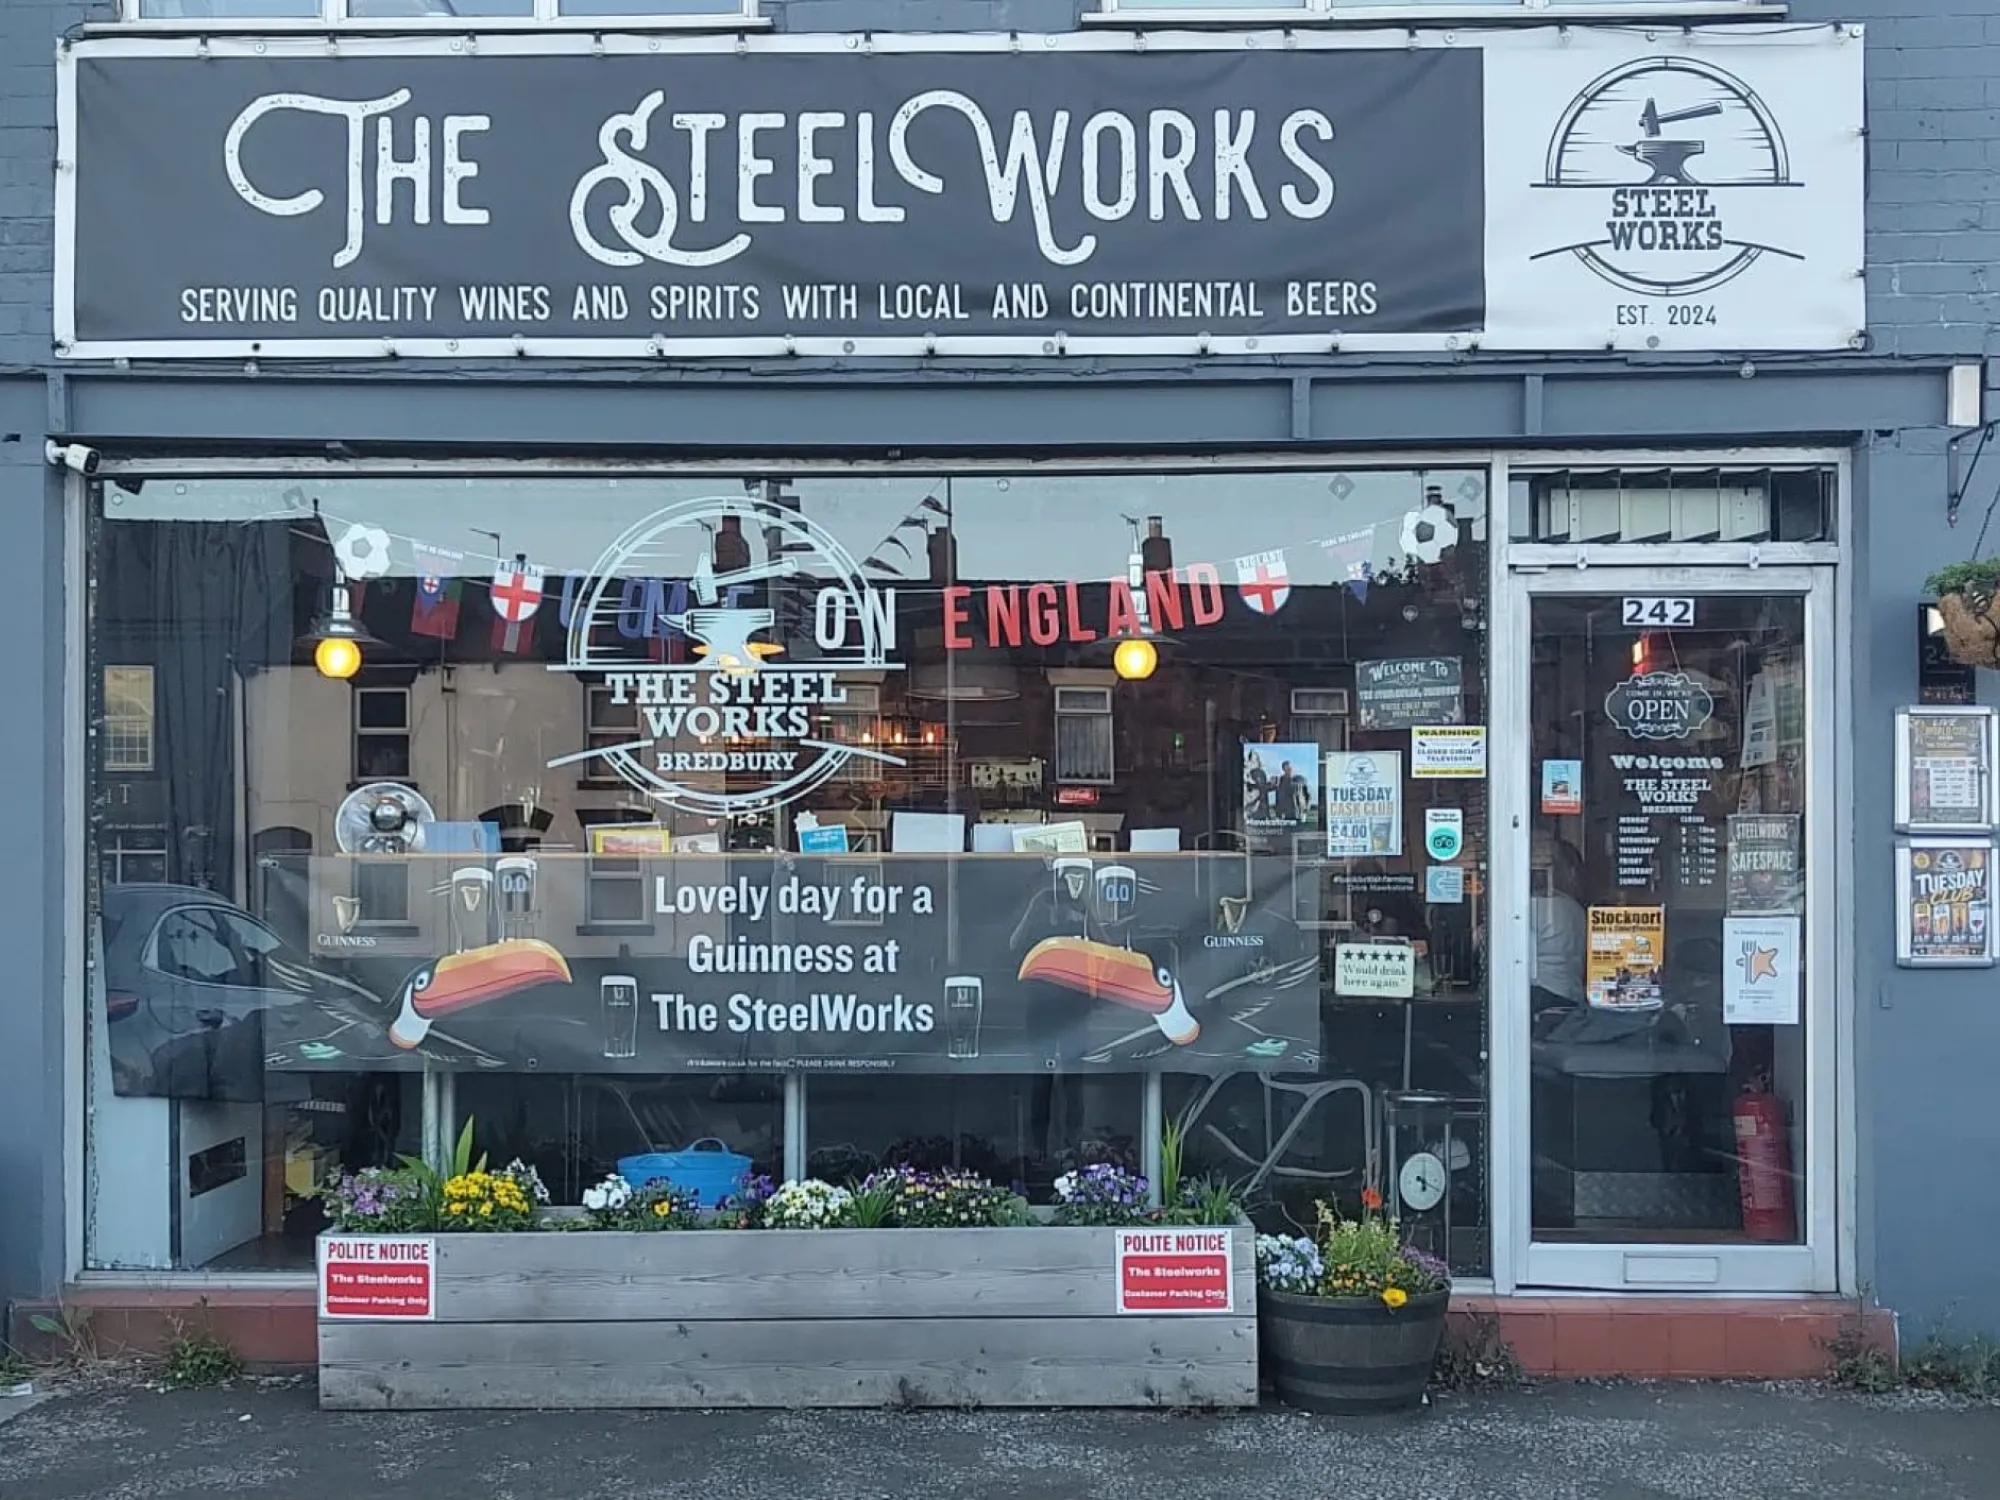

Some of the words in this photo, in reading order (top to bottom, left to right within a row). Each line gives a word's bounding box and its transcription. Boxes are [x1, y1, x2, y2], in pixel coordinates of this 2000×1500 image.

[224, 88, 490, 268] THE
[1612, 188, 1716, 218] STEEL
[1606, 221, 1723, 250] WORKS
[180, 288, 297, 323] SERVING
[318, 287, 437, 323] QUALITY
[460, 286, 551, 321] WINES
[572, 286, 628, 320] AND
[650, 286, 760, 320] SPIRITS
[782, 285, 857, 320] WITH
[879, 285, 961, 319] LOCAL
[993, 285, 1048, 319] AND
[1071, 283, 1264, 318] CONTINENTAL
[1287, 282, 1378, 317] BEERS
[1617, 305, 1653, 325] EST.
[1668, 305, 1717, 325] 2024
[815, 586, 896, 649] ON
[943, 562, 1225, 649] ENGLAND
[1626, 601, 1692, 623] 242
[1368, 661, 1426, 681] WELCOME
[604, 673, 697, 704] THE
[709, 672, 846, 703] STEEL
[1628, 700, 1690, 720] OPEN
[644, 706, 811, 738] WORKS
[657, 752, 797, 772] BREDBURY
[1611, 755, 1724, 769] Welcome
[1331, 786, 1393, 802] TUESDAY
[1624, 779, 1657, 791] THE
[1661, 779, 1712, 791] STEEL
[1638, 791, 1698, 803] WORKS
[1331, 803, 1362, 817] CASK
[1364, 802, 1394, 816] CLUB
[1731, 851, 1793, 871] SAFESPACE
[1915, 869, 1984, 896] TUESDAY
[655, 876, 769, 921] Lovely
[778, 876, 841, 921] day
[851, 876, 903, 914] for
[912, 885, 933, 914] a
[1591, 910, 1662, 927] Stockport
[317, 935, 377, 948] GUINNESS
[1204, 935, 1264, 948] GUINNESS
[688, 935, 853, 973] Guinness
[863, 939, 900, 973] at
[1379, 965, 1407, 977] drink
[1343, 977, 1368, 988] here
[651, 994, 718, 1031] The
[728, 993, 934, 1032] SteelWorks
[328, 1242, 375, 1260] POLITE
[380, 1243, 429, 1260] NOTICE
[1123, 1234, 1172, 1252] POLITE
[1175, 1234, 1226, 1251] NOTICE
[331, 1273, 354, 1284] The
[356, 1273, 424, 1285] Steelworks
[1128, 1266, 1151, 1277] The
[1154, 1265, 1221, 1277] Steelworks
